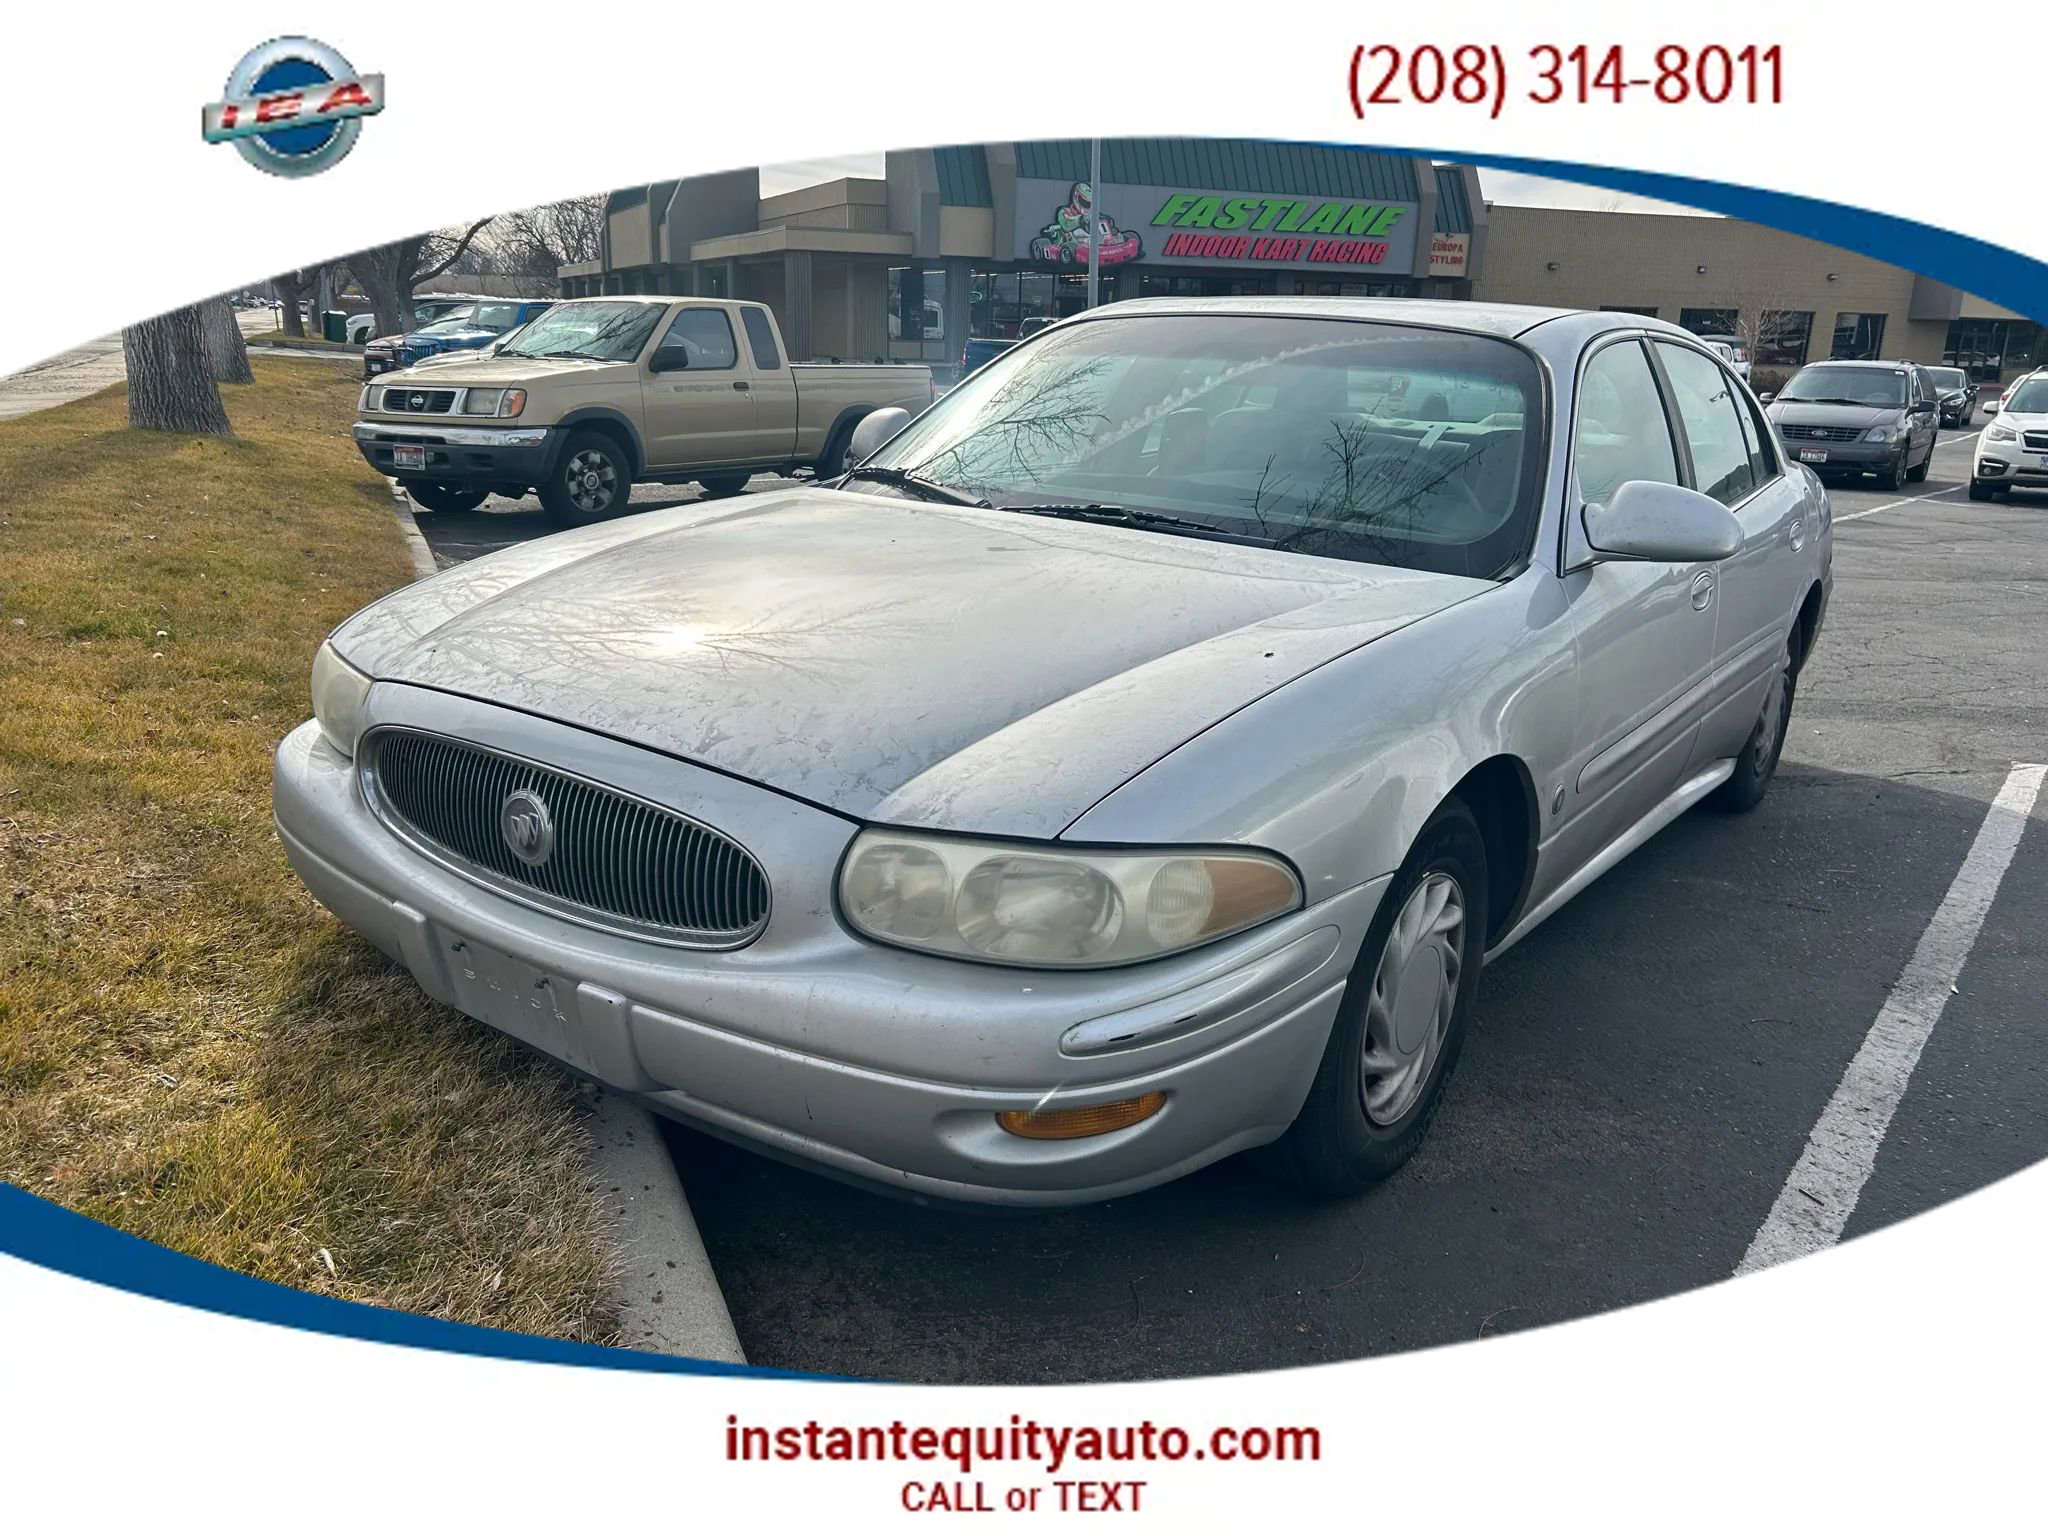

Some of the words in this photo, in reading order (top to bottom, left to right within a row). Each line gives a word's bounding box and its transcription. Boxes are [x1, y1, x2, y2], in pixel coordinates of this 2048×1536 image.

[1151, 193, 1406, 236] FASTLANE
[1163, 233, 1252, 259] INDOOR
[1250, 236, 1311, 262] KART
[1305, 239, 1390, 264] RACING
[1432, 242, 1464, 253] EUROPA
[1429, 255, 1464, 265] STYLING
